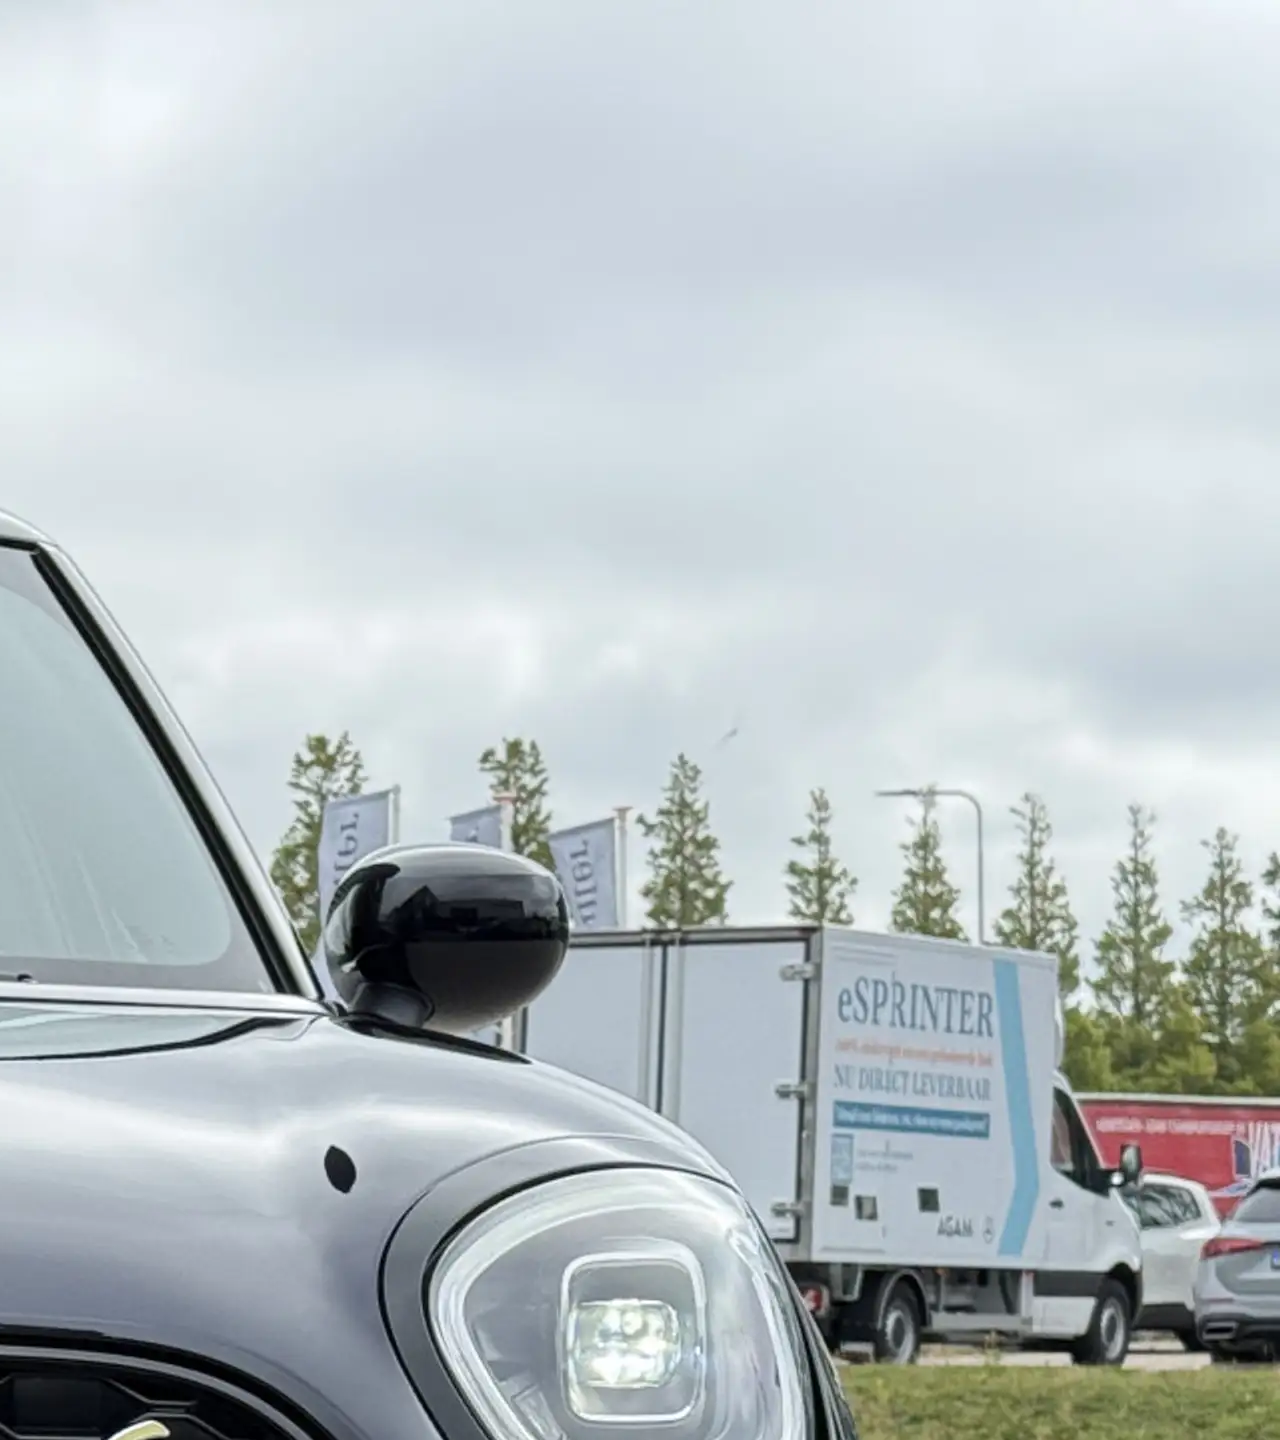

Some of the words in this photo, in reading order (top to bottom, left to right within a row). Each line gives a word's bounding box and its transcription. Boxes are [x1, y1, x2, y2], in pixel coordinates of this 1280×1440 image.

[838, 976, 994, 1037] eSPRINTER
[858, 1066, 909, 1096] DIRECT
[912, 1071, 992, 1101] LEVERBAAR
